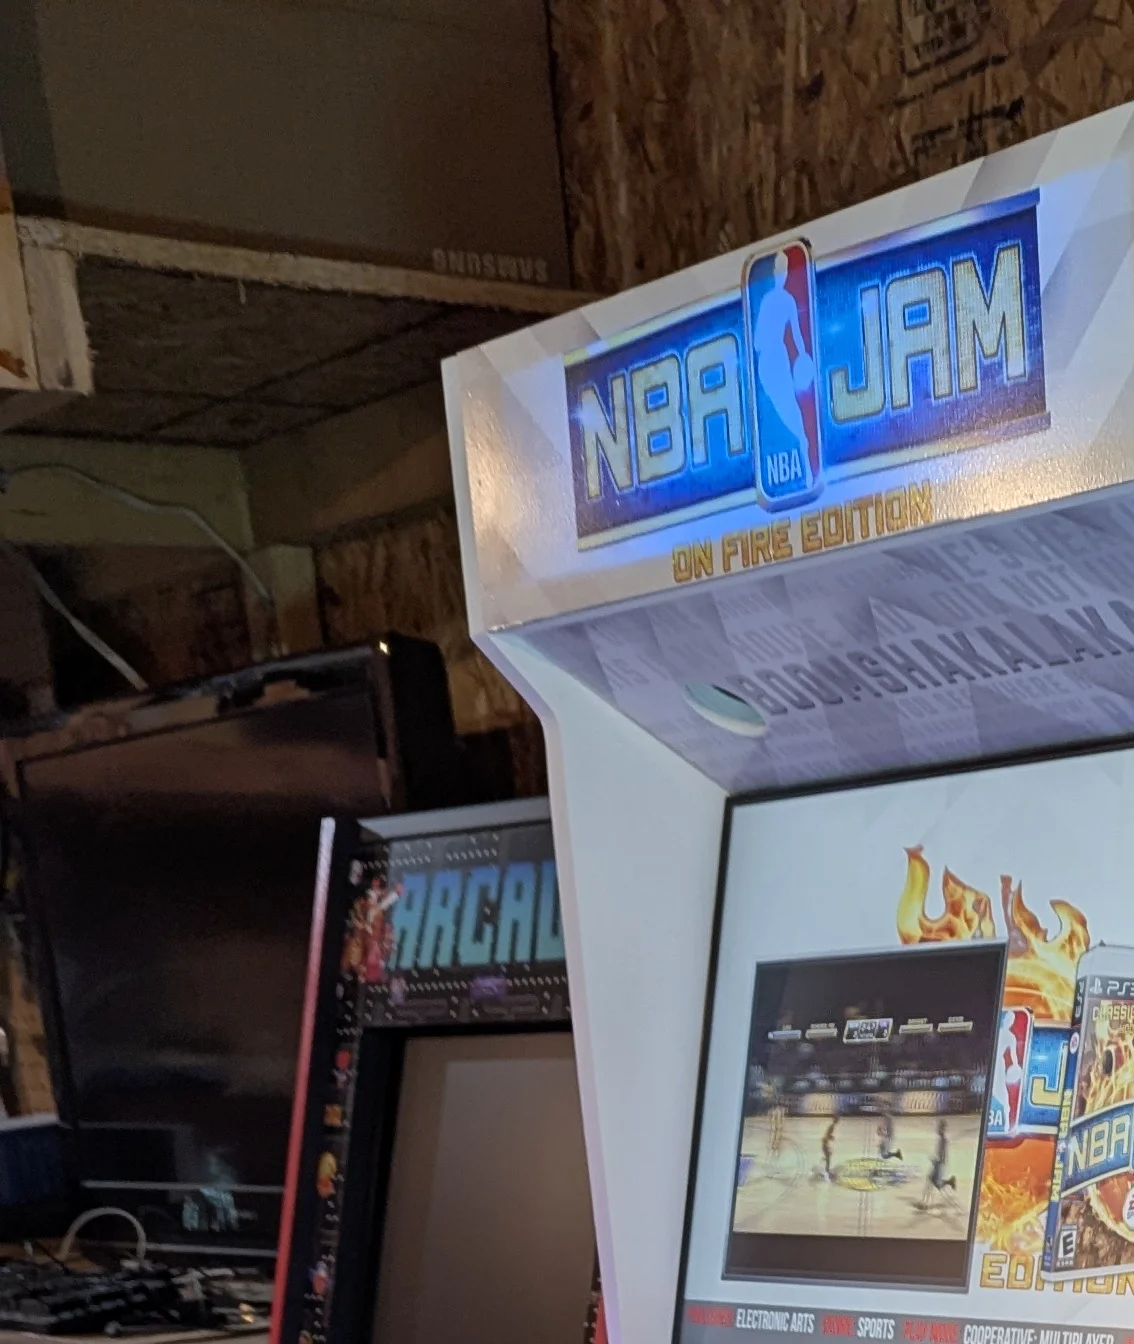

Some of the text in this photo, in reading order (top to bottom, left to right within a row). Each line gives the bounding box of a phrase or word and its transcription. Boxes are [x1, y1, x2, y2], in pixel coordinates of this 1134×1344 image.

[579, 241, 1028, 501] NBA JAM
[766, 448, 802, 488] NBA
[672, 481, 934, 583] ON FIRE EDITION
[1068, 1114, 1131, 1177] NBA
[735, 1308, 790, 1332] ELECTRONIC
[790, 1312, 815, 1334] ARTS
[857, 1316, 896, 1340] SPORTS
